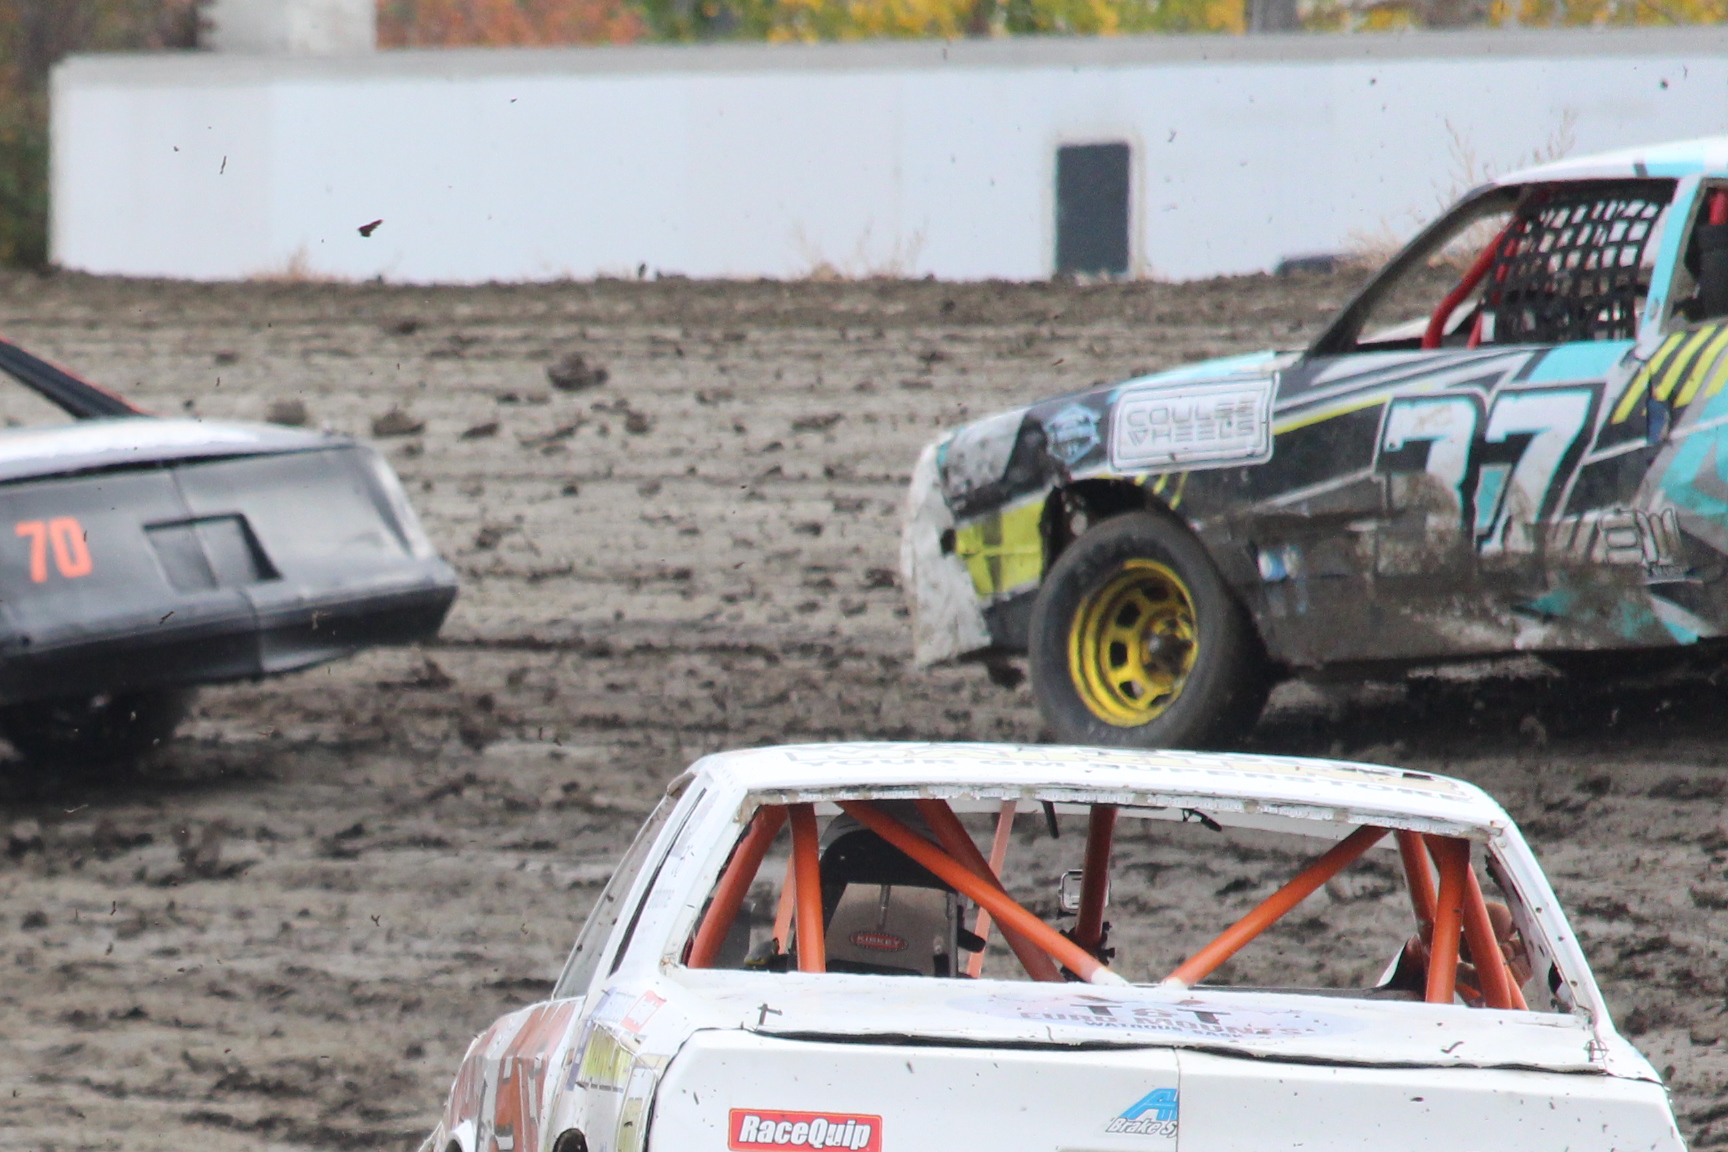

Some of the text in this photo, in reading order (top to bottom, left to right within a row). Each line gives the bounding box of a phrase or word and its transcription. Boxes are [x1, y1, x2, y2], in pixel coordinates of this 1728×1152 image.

[1378, 388, 1596, 560] 77
[15, 516, 94, 583] 70
[738, 1115, 872, 1151] RaceQuip
[1105, 1117, 1162, 1136] Brake
